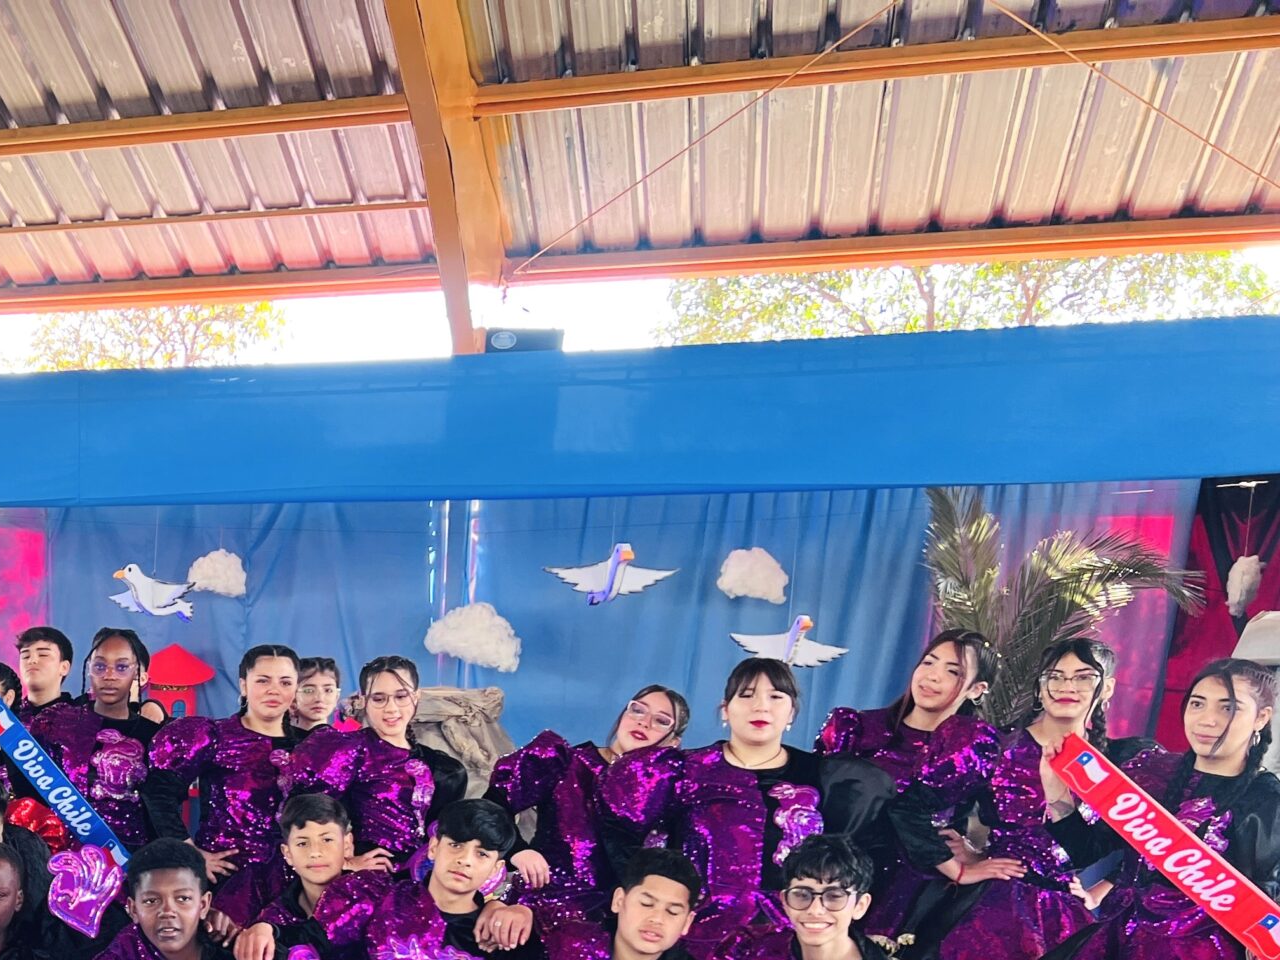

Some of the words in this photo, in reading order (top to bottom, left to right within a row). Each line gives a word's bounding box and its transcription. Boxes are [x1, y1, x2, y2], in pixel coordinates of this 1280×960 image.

[13, 739, 54, 791] Viva
[48, 786, 92, 836] Chile
[1108, 792, 1173, 856] Viva
[1162, 848, 1236, 911] Chile
